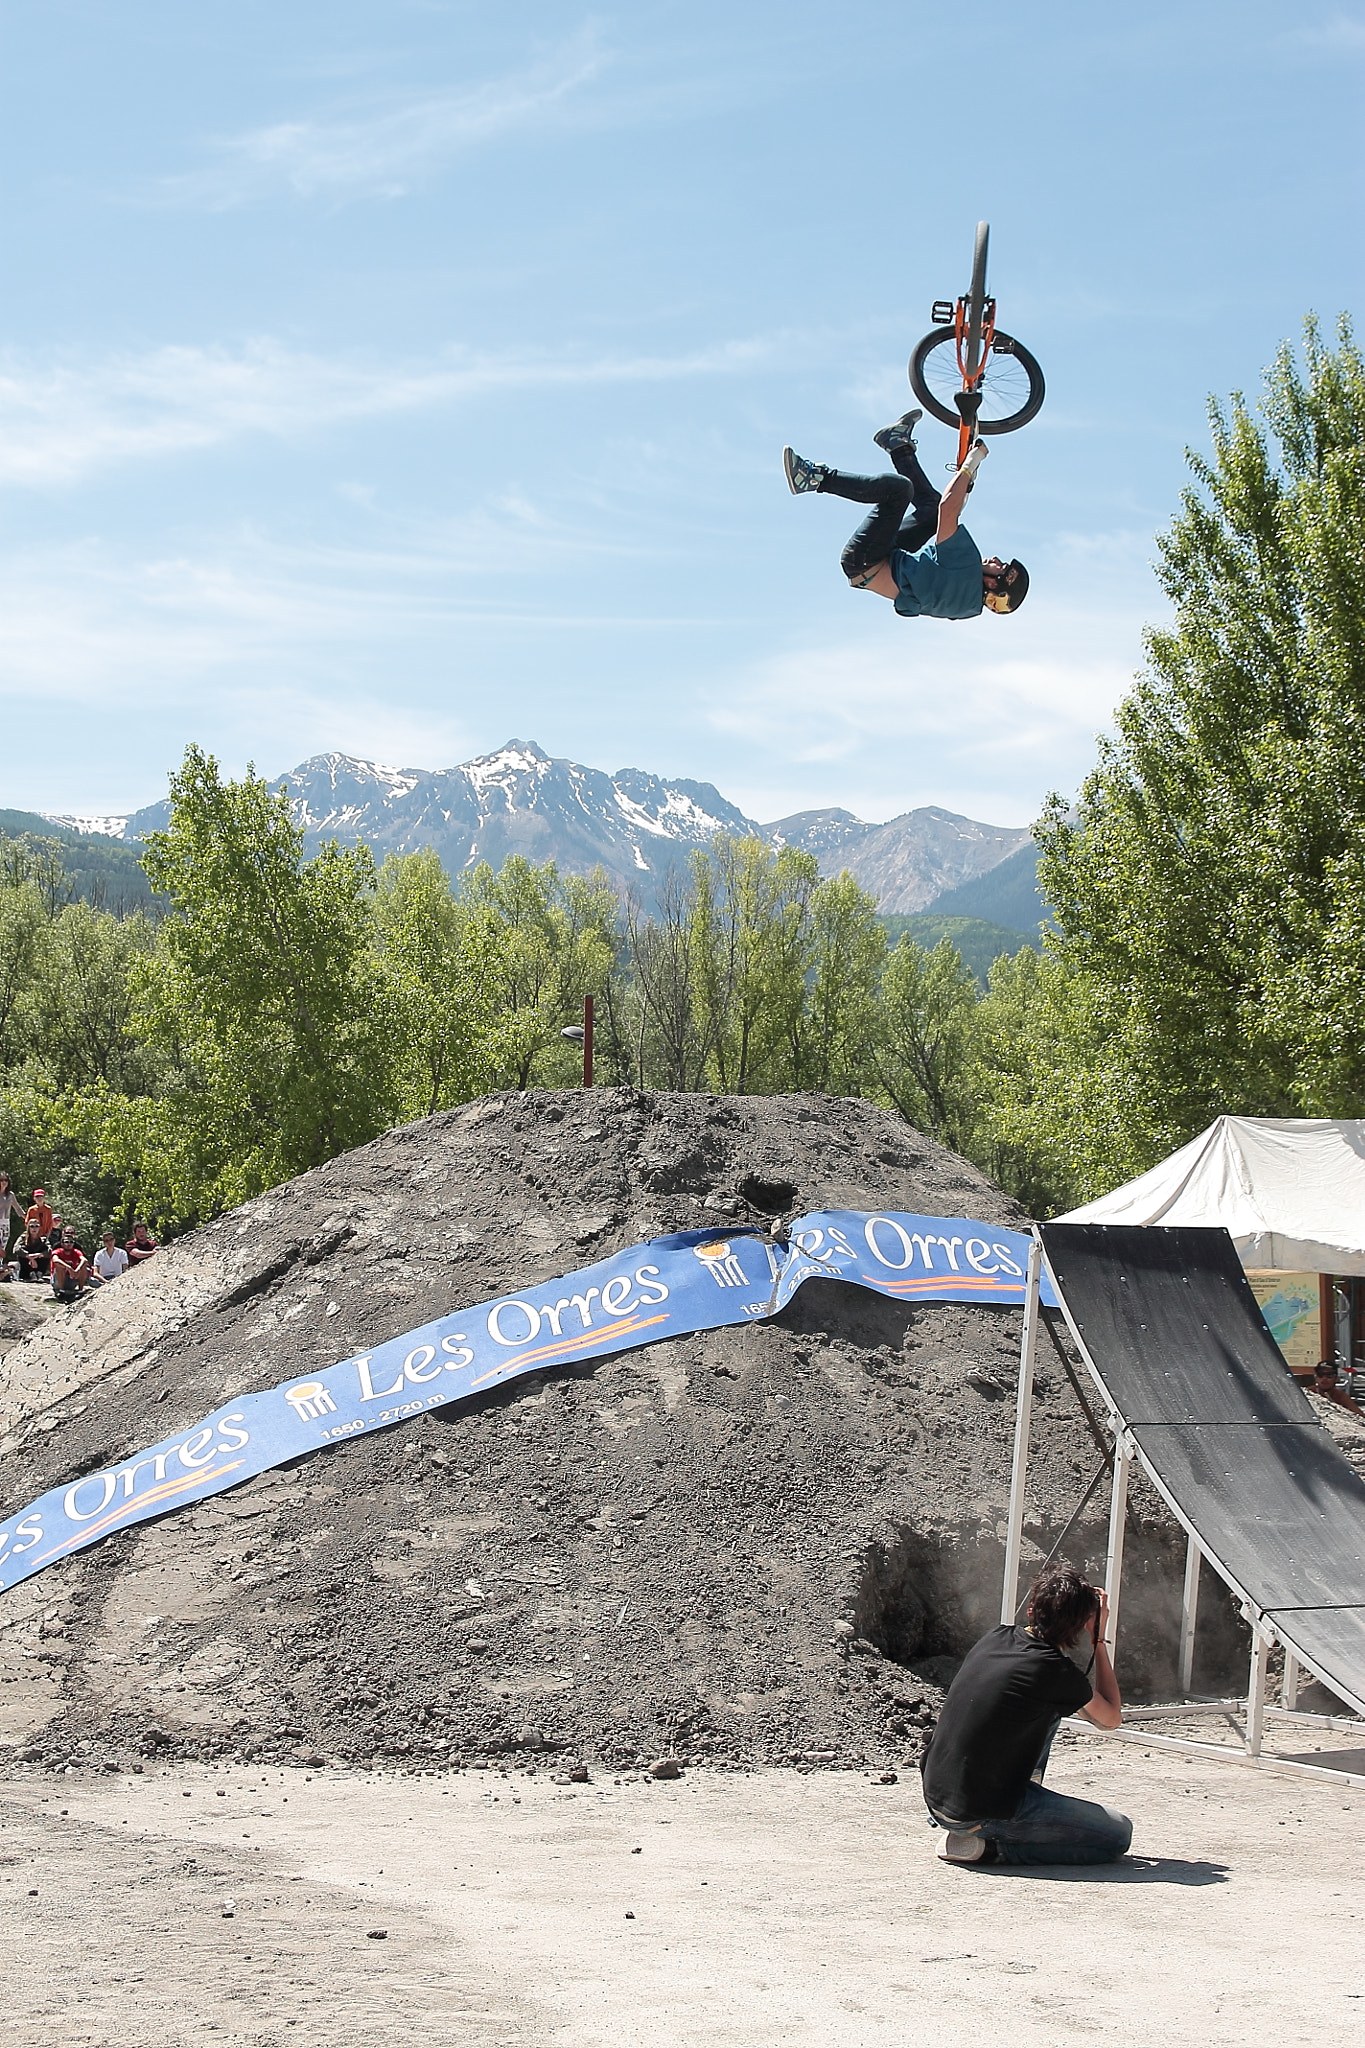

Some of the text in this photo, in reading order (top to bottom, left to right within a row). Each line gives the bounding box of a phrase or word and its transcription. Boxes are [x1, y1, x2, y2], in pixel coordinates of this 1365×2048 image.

[864, 1217, 1023, 1277] Orres
[352, 1265, 670, 1402] Les Orres
[320, 1419, 366, 1440] 1650
[378, 1400, 424, 1422] 2720
[426, 1393, 447, 1405] m
[63, 1413, 249, 1521] Orres
